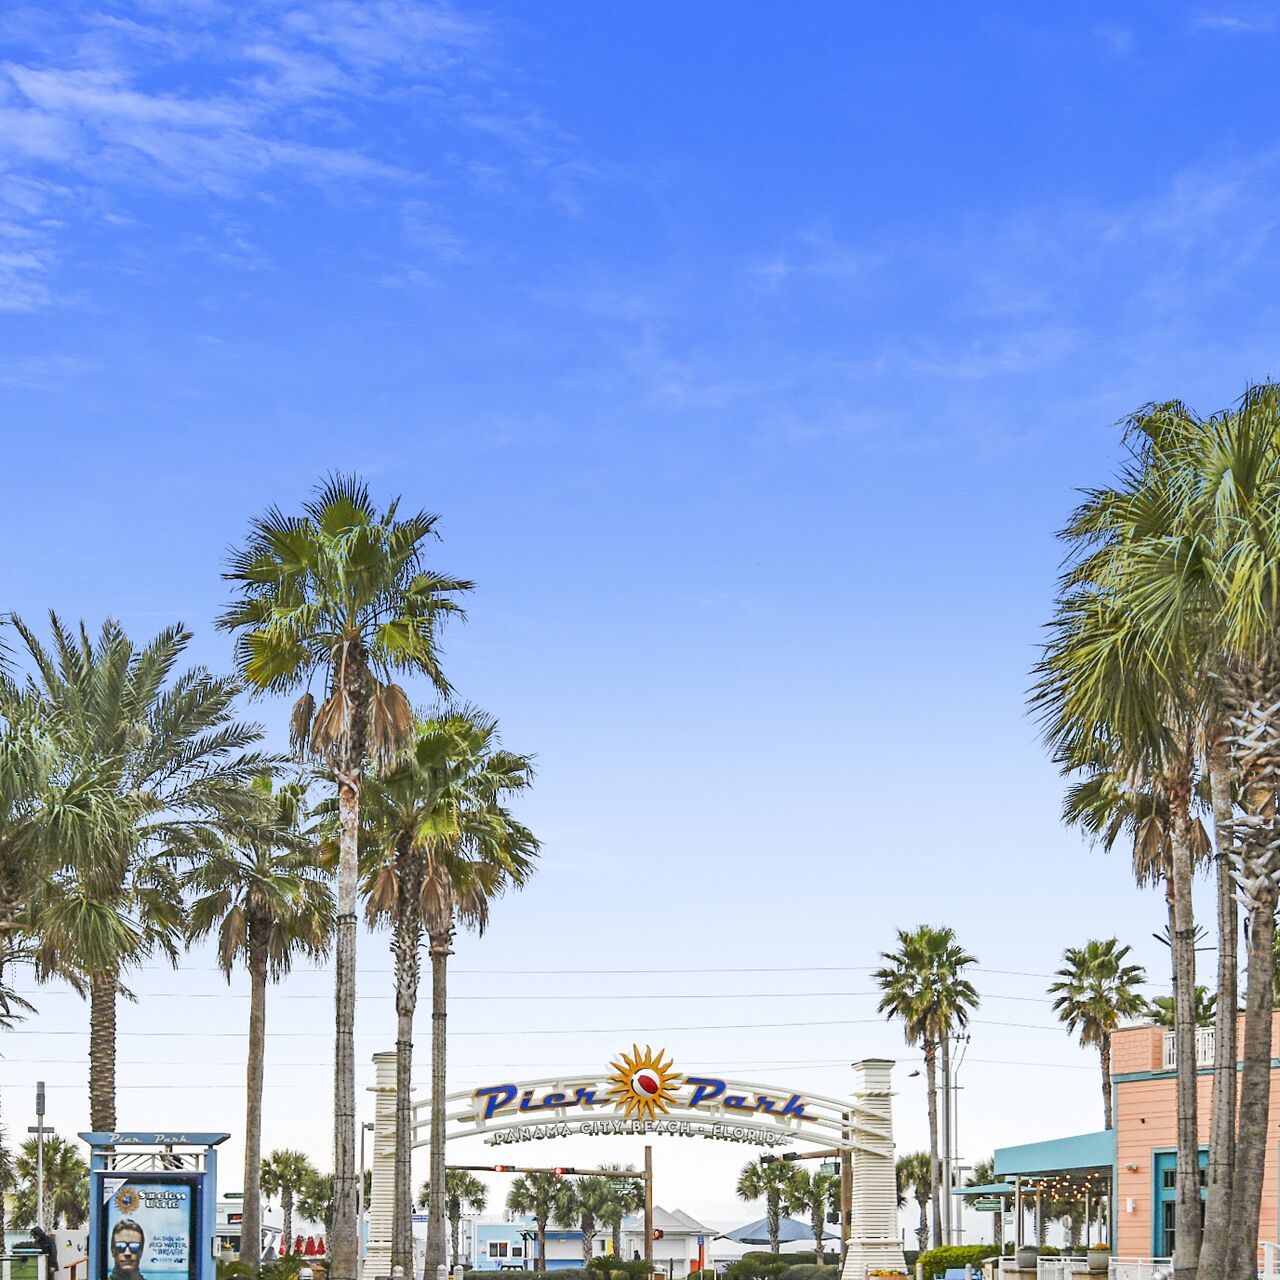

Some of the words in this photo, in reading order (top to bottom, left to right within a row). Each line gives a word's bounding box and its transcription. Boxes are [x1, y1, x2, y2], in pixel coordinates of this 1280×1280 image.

[473, 1082, 611, 1120] Pier
[680, 1076, 819, 1121] Park
[108, 1133, 142, 1143] Pier
[153, 1134, 190, 1143] Park
[494, 1123, 572, 1145] PANAMA
[580, 1121, 623, 1135] CITY
[633, 1120, 691, 1135] BEACH
[712, 1125, 787, 1146] FLORIDA
